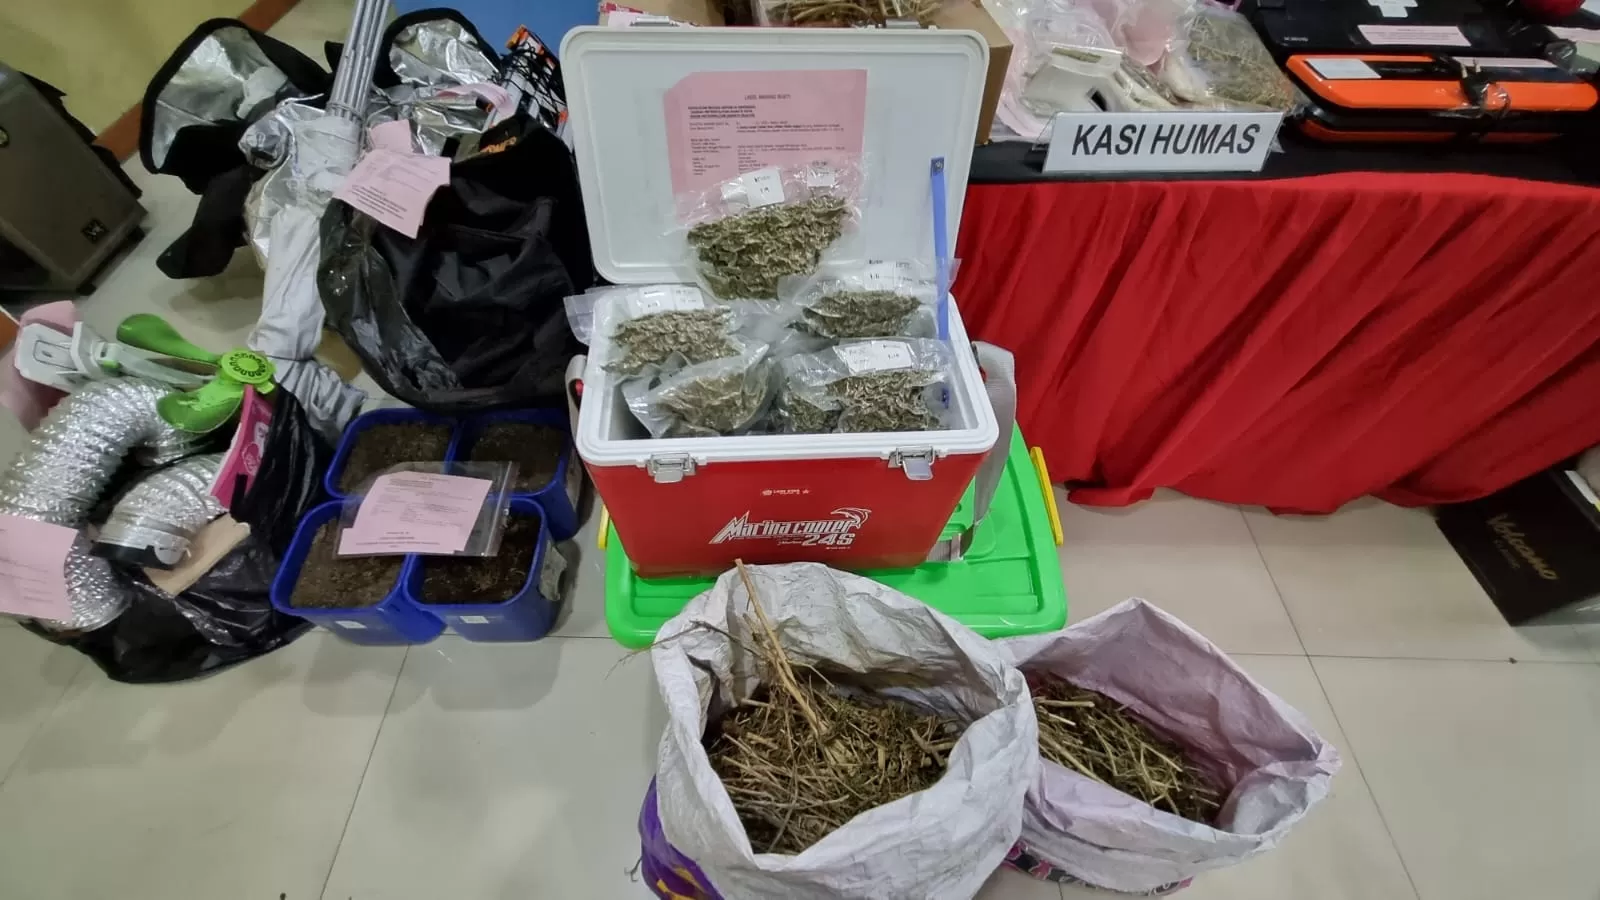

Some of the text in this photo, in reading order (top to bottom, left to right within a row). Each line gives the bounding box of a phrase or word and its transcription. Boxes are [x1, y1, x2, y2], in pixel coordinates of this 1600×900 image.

[1071, 123, 1261, 156] KASI HUMAS
[708, 510, 854, 545] Marina cooler
[802, 533, 856, 546] 24S
